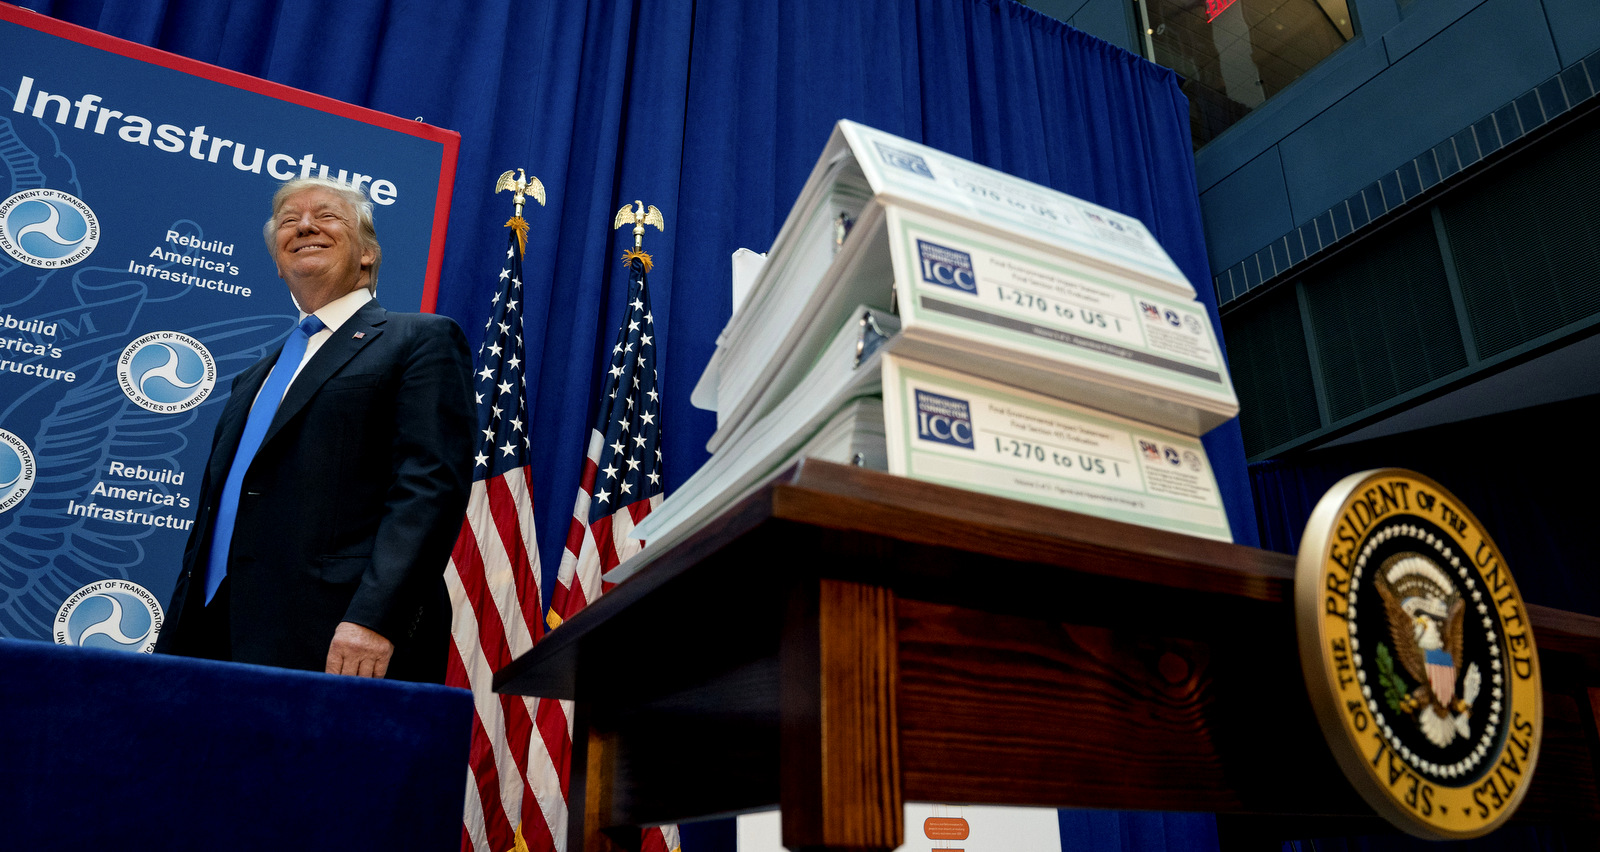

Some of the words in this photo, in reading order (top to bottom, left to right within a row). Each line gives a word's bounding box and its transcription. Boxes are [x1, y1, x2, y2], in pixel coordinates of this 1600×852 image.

[13, 76, 398, 206] Infrastructure
[0, 190, 40, 219] DEPARTMENT
[57, 192, 98, 241] TRANSPORTATION
[12, 249, 42, 266] STATES
[60, 245, 92, 266] AMERICA
[165, 230, 235, 256] Rebuild
[128, 260, 252, 297] Infrastructure
[923, 258, 975, 291] ICC
[0, 314, 58, 337] build
[997, 286, 1047, 312] I-270
[1054, 303, 1074, 319] to
[1080, 309, 1107, 329] US
[0, 337, 62, 359] erica's
[121, 333, 160, 365] DEPARTMENT
[175, 334, 214, 382] TRANSPORTATION
[0, 360, 76, 383] ructure
[120, 371, 136, 397] UNITED
[135, 396, 164, 411] STATES
[180, 387, 210, 410] AMERICA
[920, 412, 972, 444] ICC
[0, 432, 33, 481] ANSPORTATION
[108, 461, 185, 486] Rebuild
[995, 437, 1045, 463] I-270
[1053, 452, 1073, 468] to
[1078, 454, 1106, 475] US
[0, 488, 26, 510] MERICA
[67, 500, 195, 531] Infrastructur
[1440, 502, 1468, 539] THE
[1326, 481, 1410, 621] PRESIDENT
[58, 583, 102, 623] DEPARTMENT
[119, 582, 162, 634] TRANSPORTATION
[1474, 540, 1532, 681] UNITED
[1332, 637, 1353, 691] THE
[1373, 731, 1434, 817] SEAL
[1472, 712, 1533, 820] STATES
